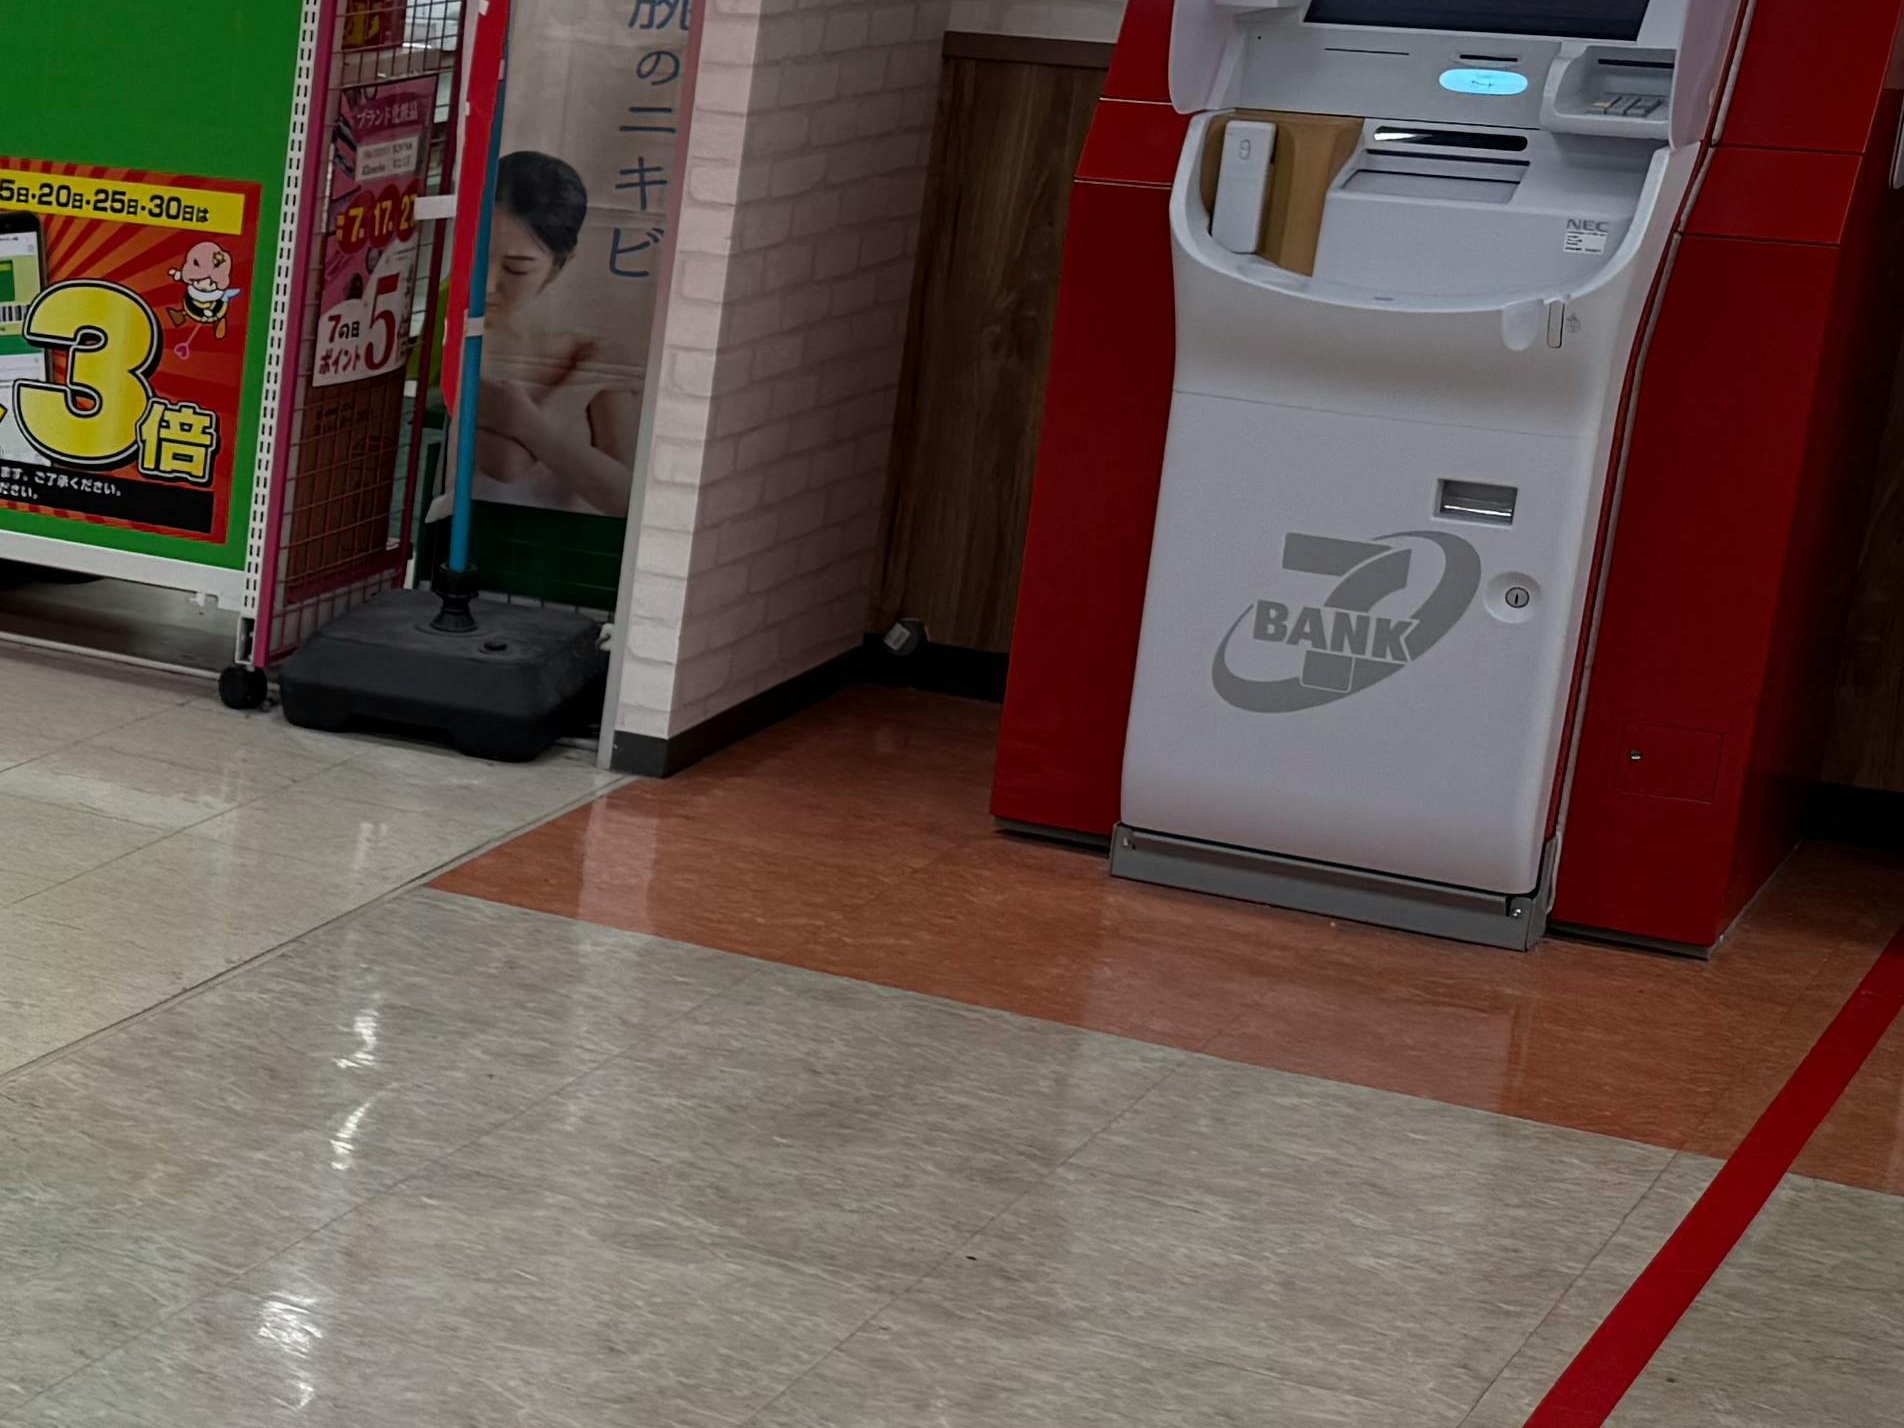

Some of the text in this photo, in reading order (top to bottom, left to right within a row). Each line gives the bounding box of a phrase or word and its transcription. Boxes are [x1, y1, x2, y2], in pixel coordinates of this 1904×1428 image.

[1565, 219, 1612, 234] NEC
[327, 314, 360, 343] 7の日
[364, 272, 400, 370] 5
[13, 278, 220, 481] 3 倍
[319, 344, 361, 375] ポイント
[1252, 598, 1414, 664] BANK
